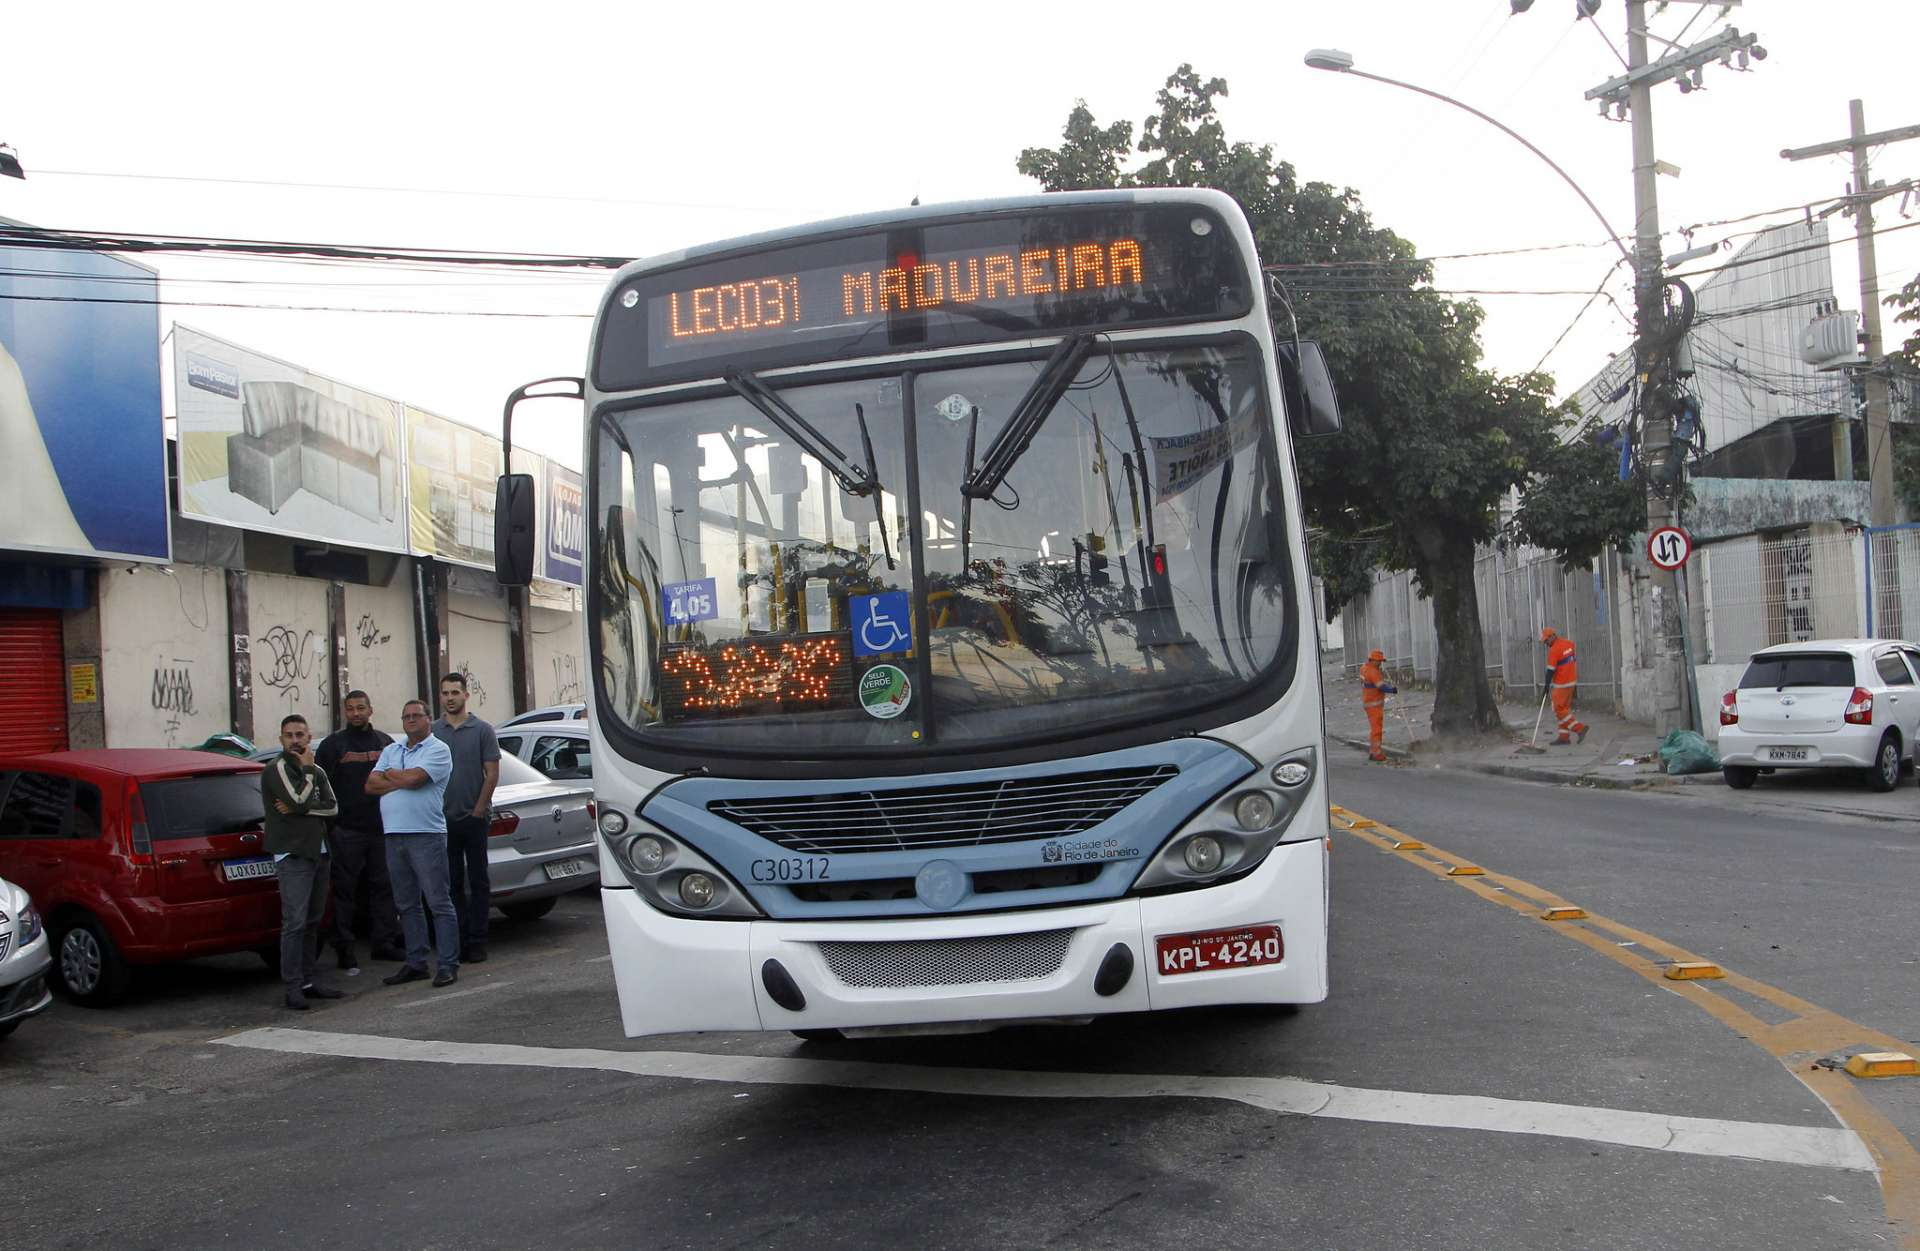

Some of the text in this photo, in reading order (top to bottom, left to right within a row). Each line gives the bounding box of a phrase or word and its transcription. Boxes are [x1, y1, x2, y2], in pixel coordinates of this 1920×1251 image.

[842, 239, 1142, 316] MADUREIRA
[673, 583, 703, 595] TARIFA
[868, 671, 886, 680] SELO
[863, 676, 892, 689] VERDE
[1063, 838, 1118, 851] Cidade do
[1064, 847, 1140, 862] Rio de Janeiro
[750, 857, 830, 882] C30312
